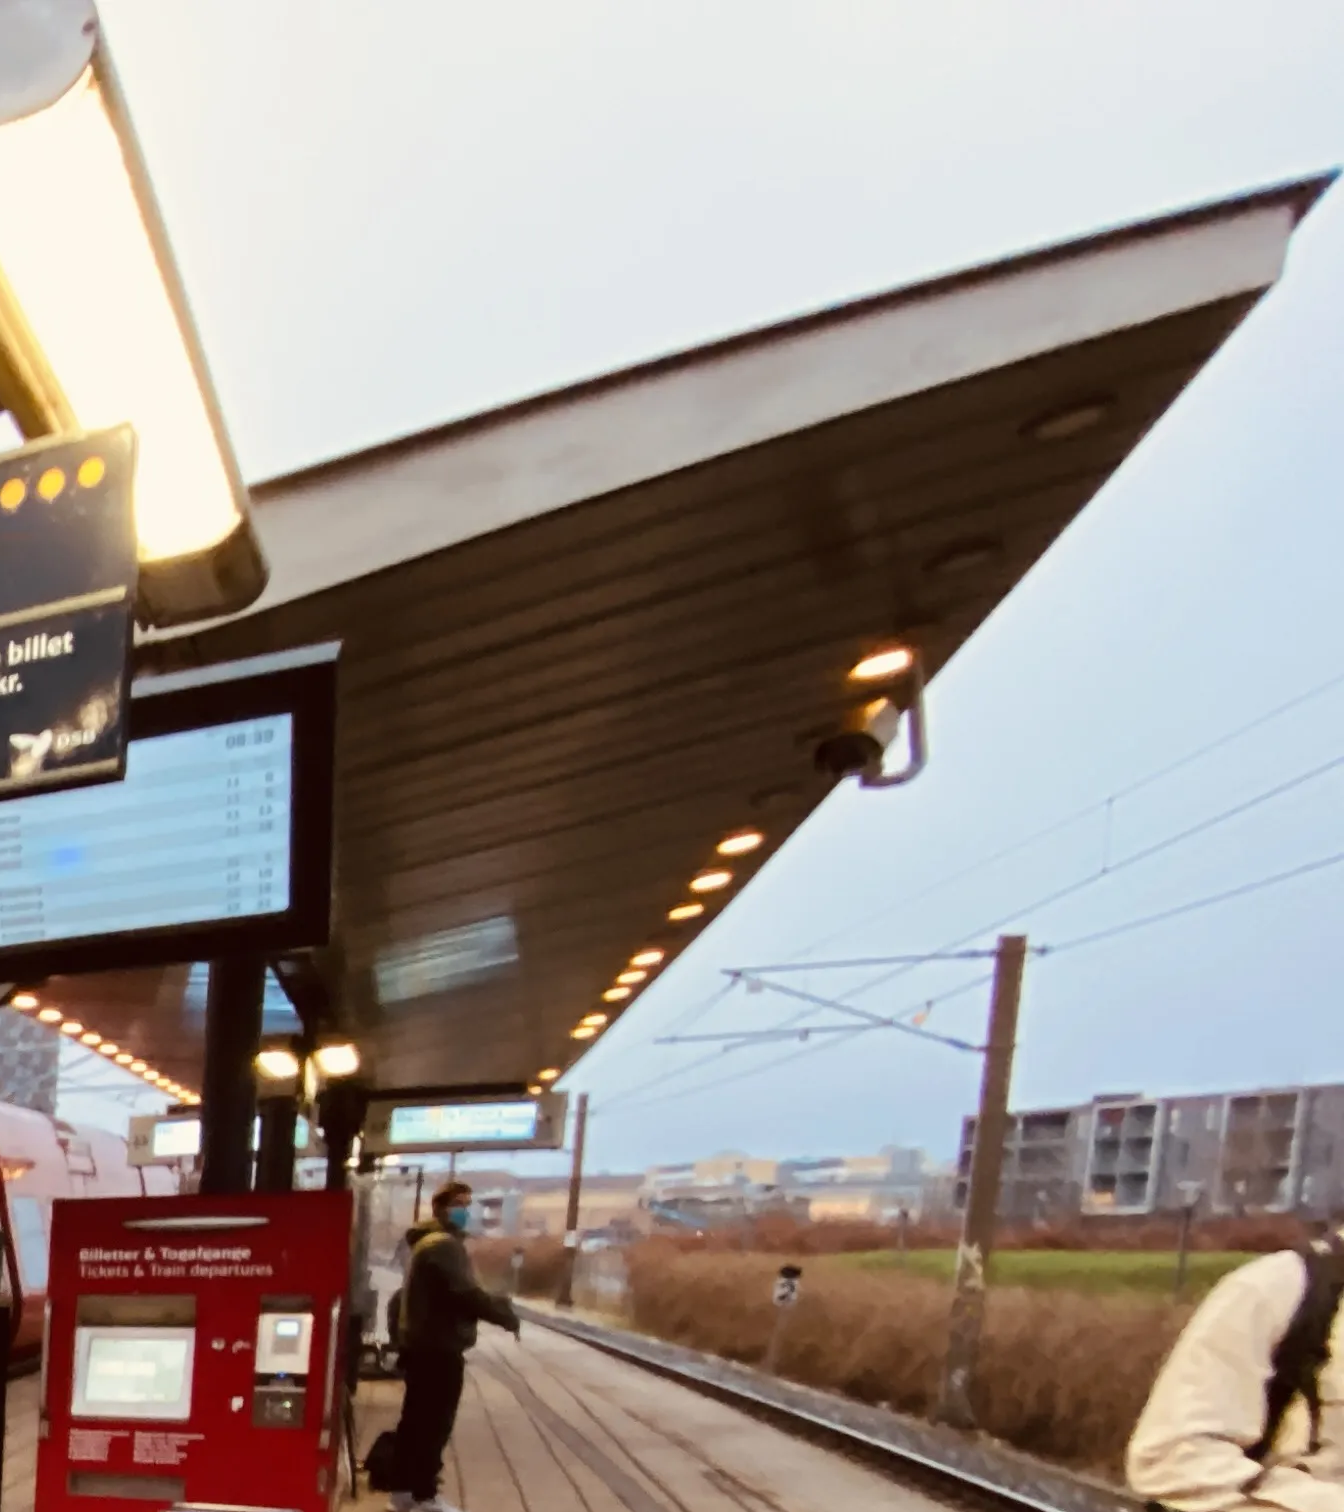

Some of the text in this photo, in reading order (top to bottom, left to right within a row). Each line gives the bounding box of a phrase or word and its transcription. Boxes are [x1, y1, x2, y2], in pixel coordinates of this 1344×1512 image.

[8, 631, 74, 666] billet
[79, 1247, 140, 1262] Billetter
[144, 1246, 156, 1261] &
[80, 1263, 273, 1279] Tickets & Train departures
